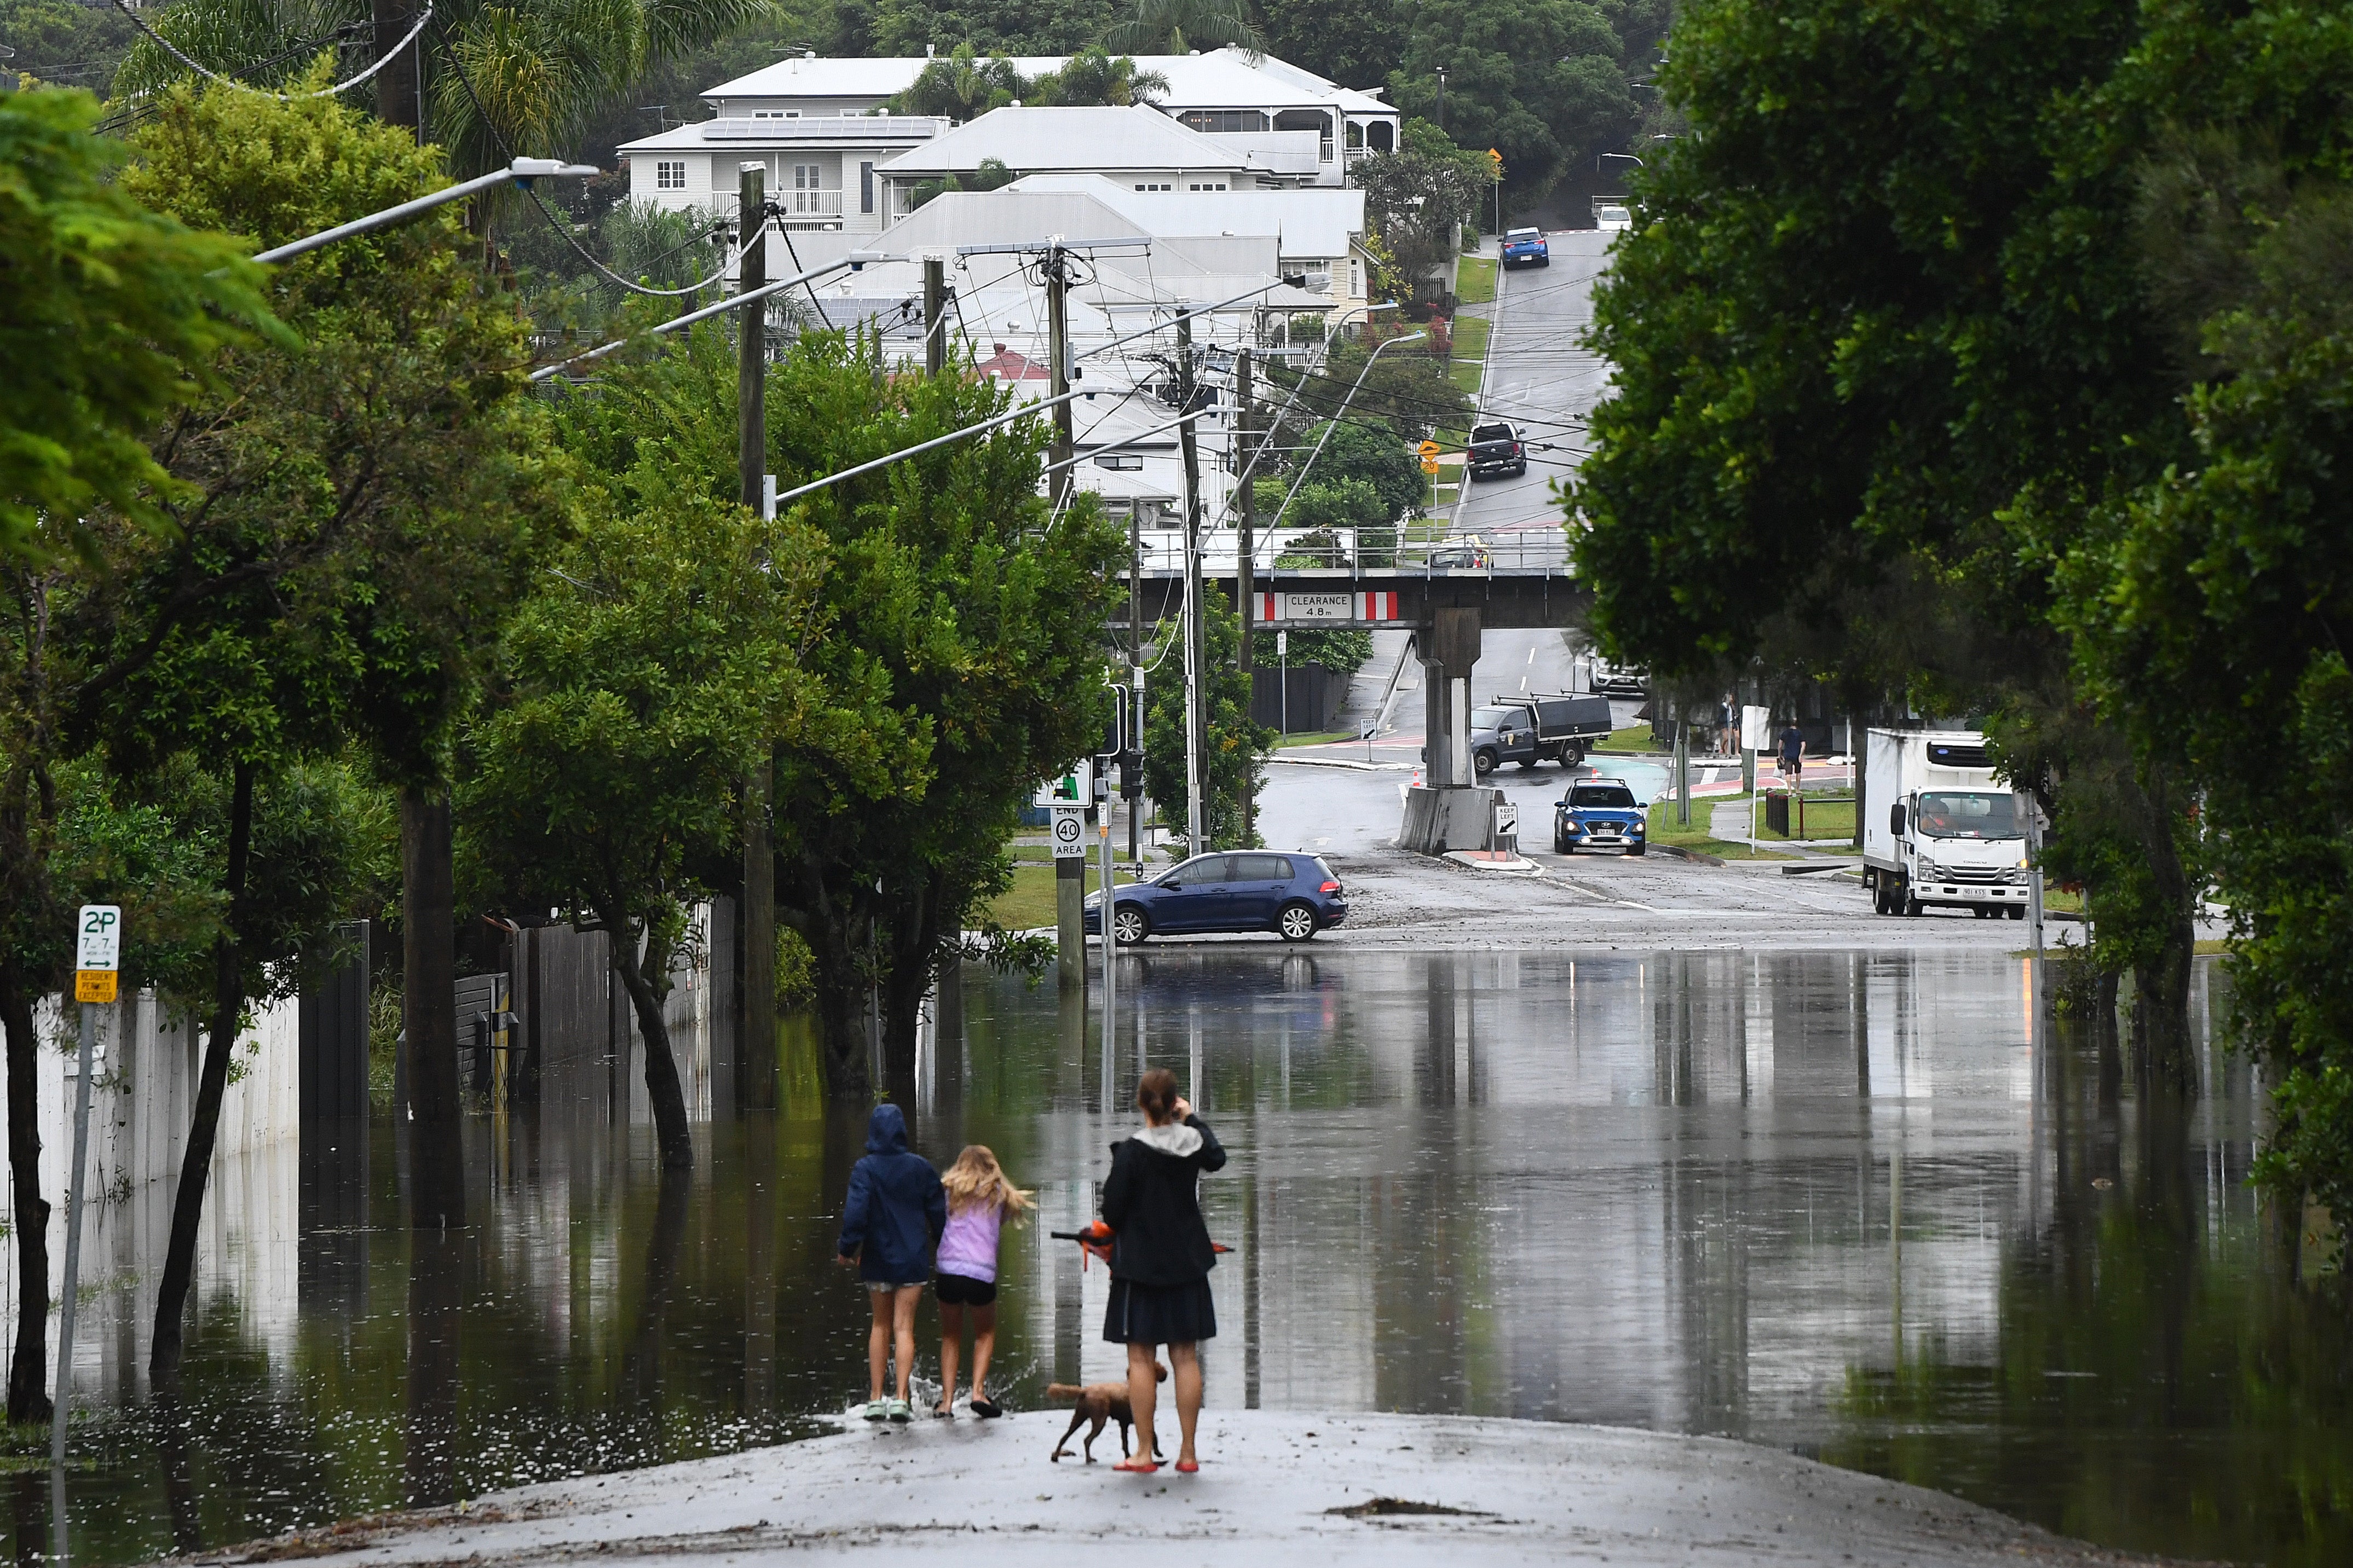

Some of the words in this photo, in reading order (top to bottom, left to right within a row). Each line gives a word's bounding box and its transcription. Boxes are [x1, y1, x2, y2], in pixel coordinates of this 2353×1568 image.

[1291, 597, 1347, 605] CLEARANCE
[1306, 607, 1324, 616] 4.8
[1060, 824, 1077, 836] 40
[1056, 846, 1082, 854] AREA
[85, 911, 116, 934] 2P
[83, 937, 90, 948] 7
[102, 938, 109, 949] 7
